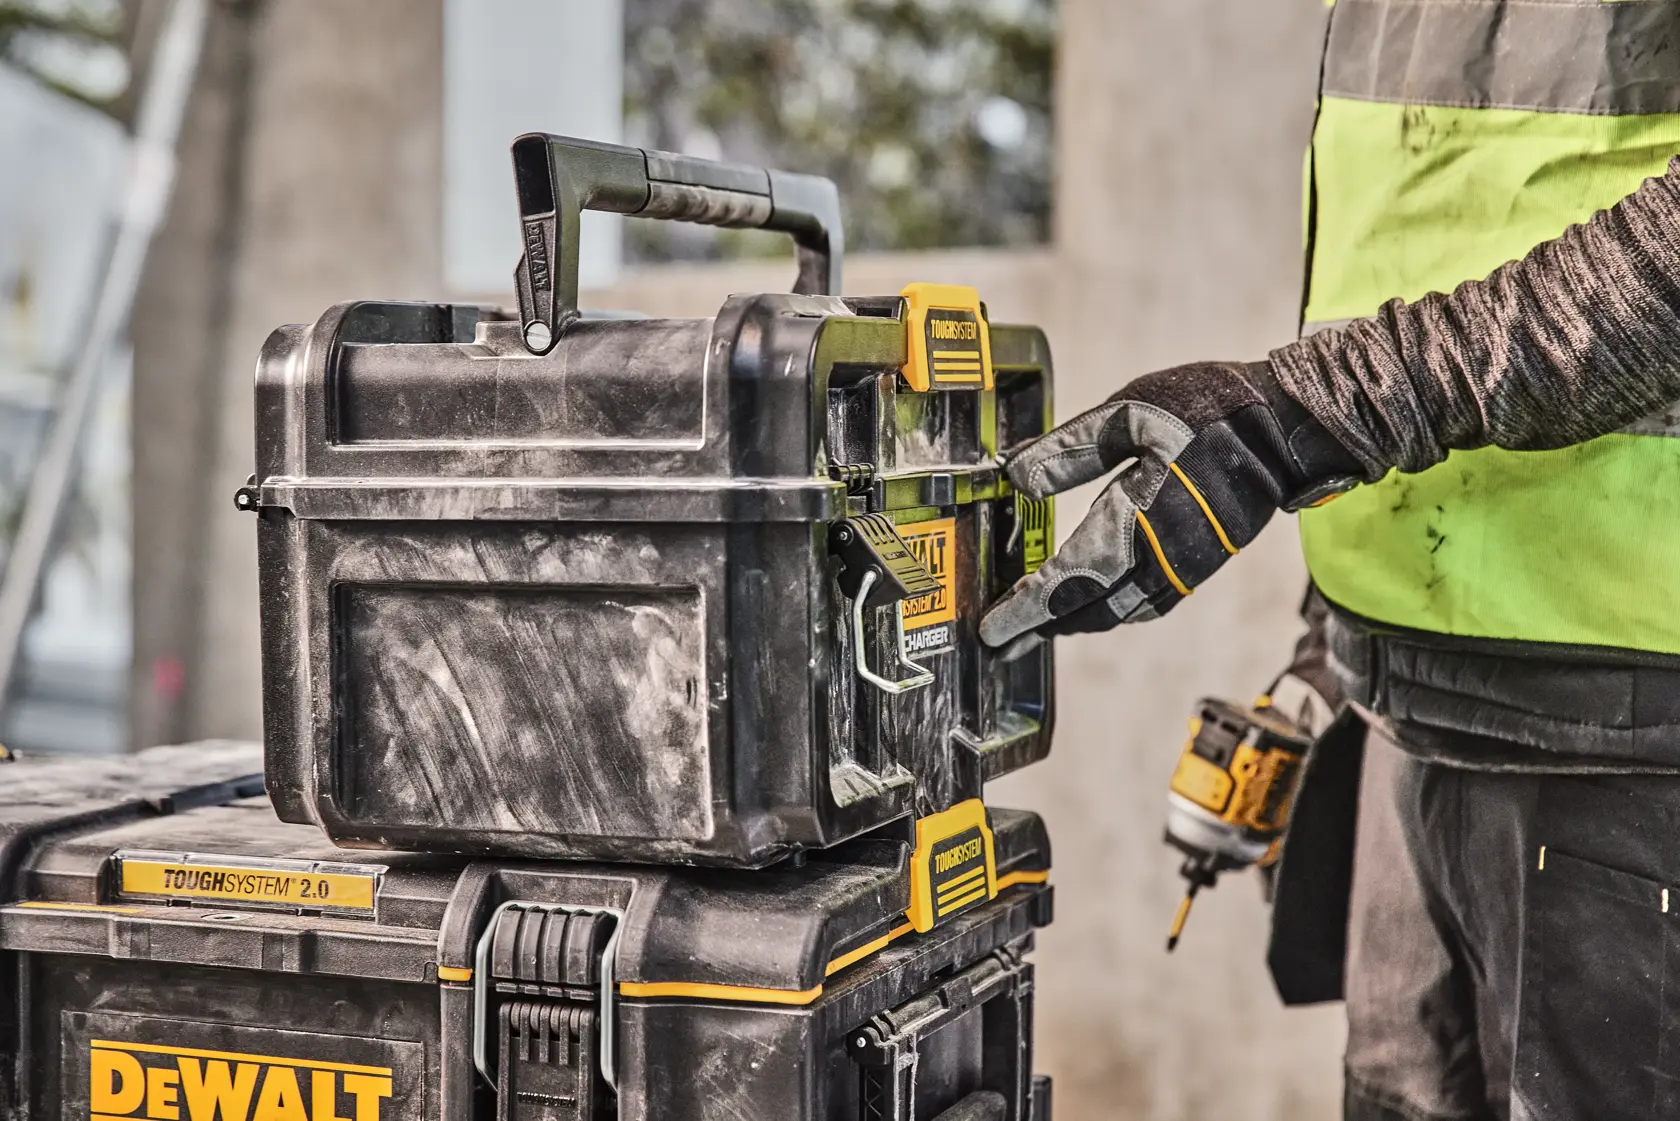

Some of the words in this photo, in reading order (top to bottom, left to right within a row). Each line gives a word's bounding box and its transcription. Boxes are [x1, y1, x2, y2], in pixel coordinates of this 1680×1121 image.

[931, 319, 977, 340] TOUGHSYSTEM
[935, 837, 982, 874] TOUGHSYSTEM
[299, 878, 330, 899] 2.0
[91, 1049, 392, 1121] DEWALT
